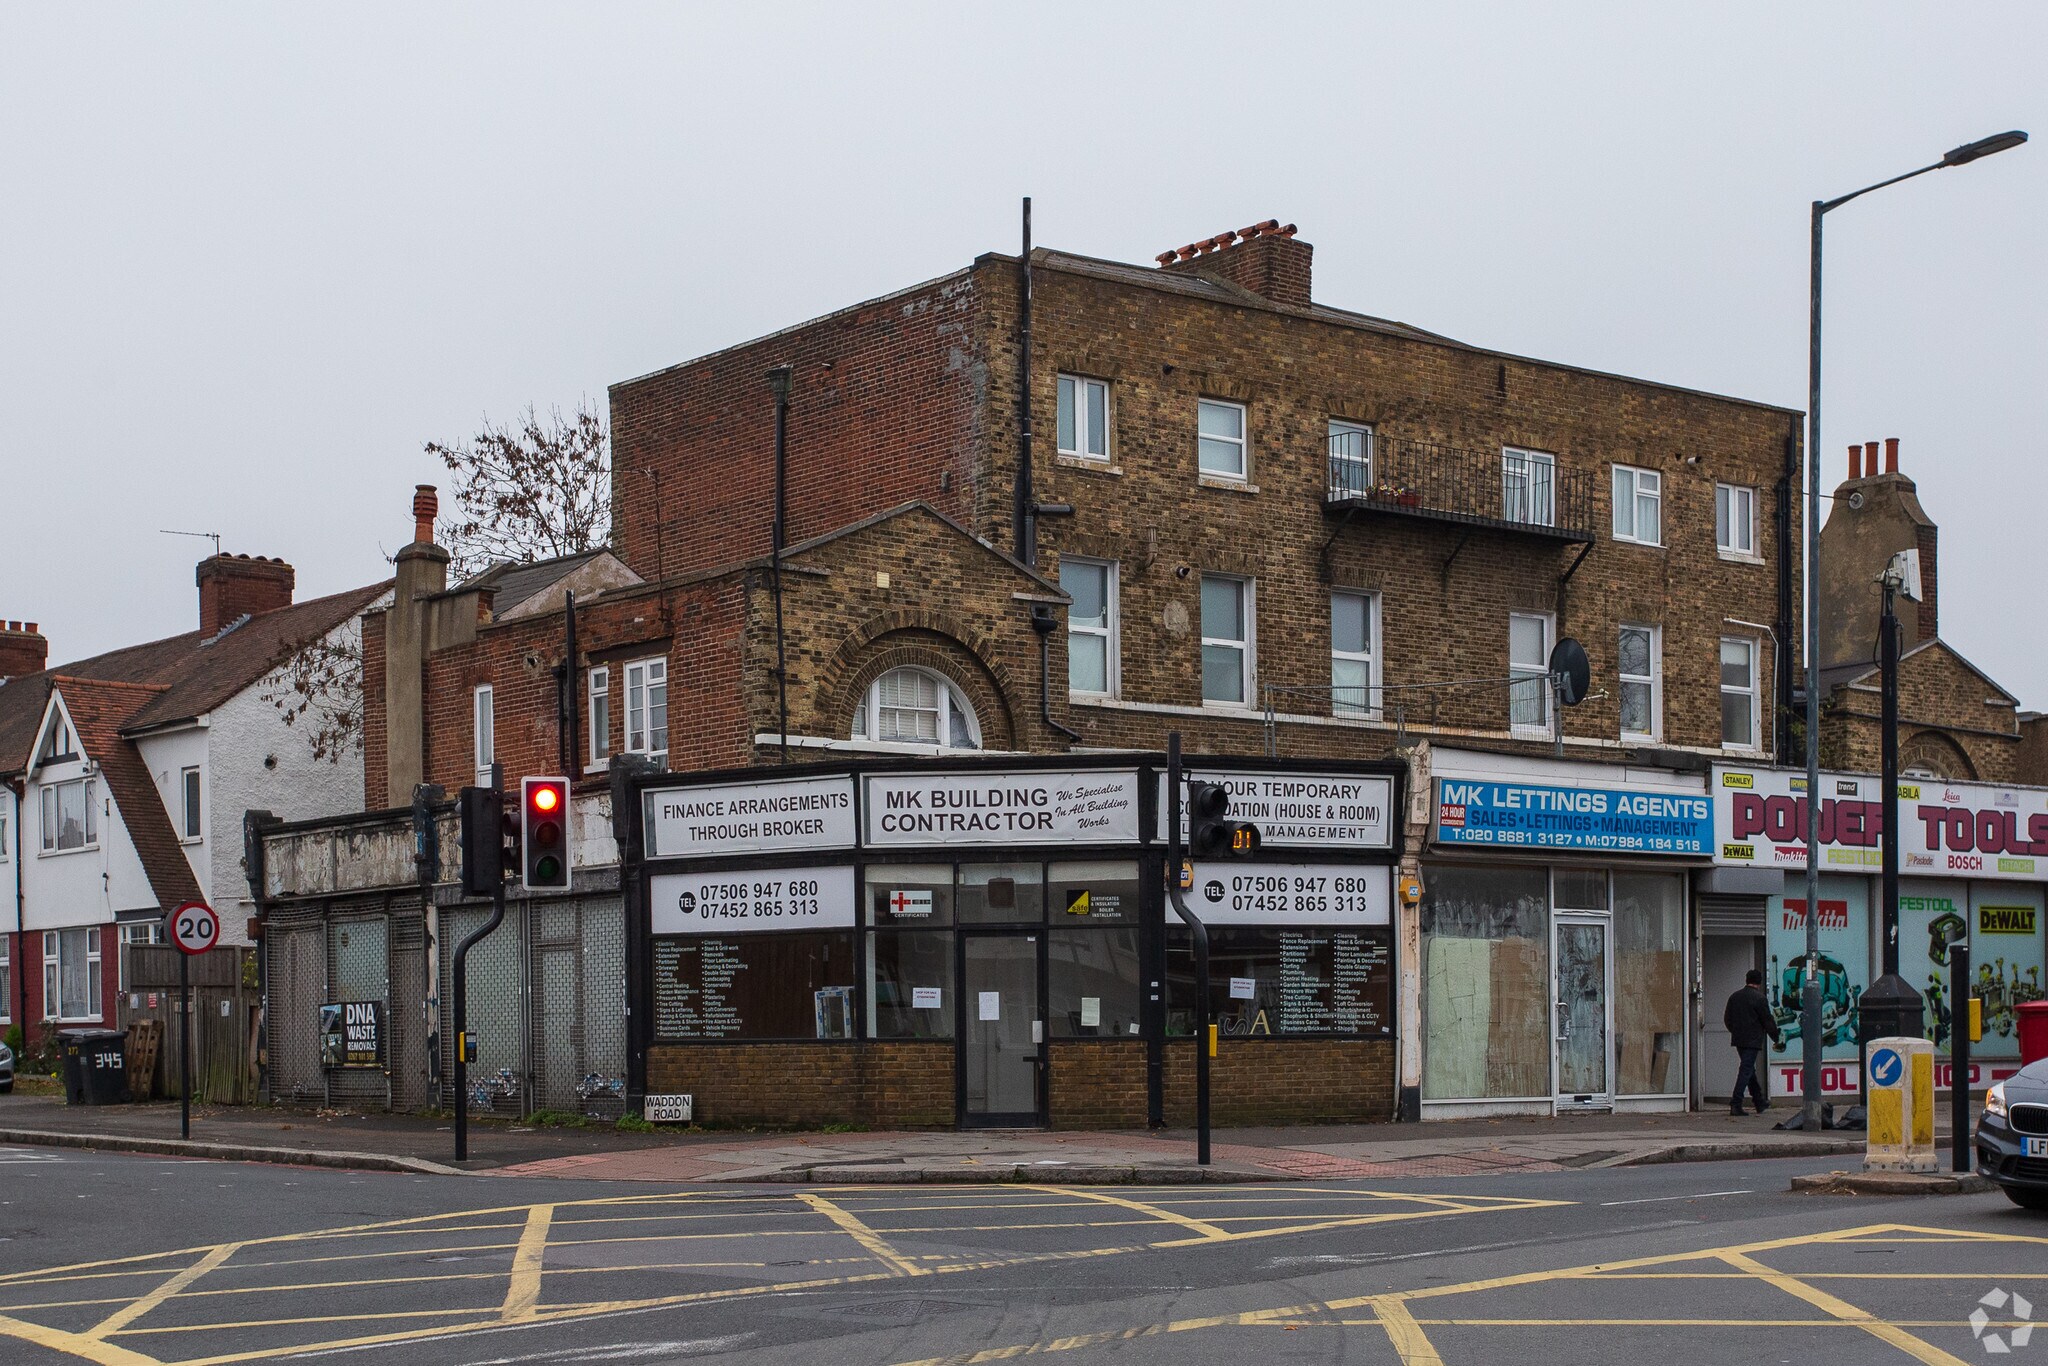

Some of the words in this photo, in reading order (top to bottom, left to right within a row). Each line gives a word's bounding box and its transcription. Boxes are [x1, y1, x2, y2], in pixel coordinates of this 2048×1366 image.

[1725, 776, 1751, 785] STANLEY
[1838, 782, 1856, 791] trend
[887, 791, 922, 808] MK
[931, 788, 1048, 808] BUILDING
[1056, 791, 1073, 801] We
[1075, 784, 1123, 800] Specialise
[1263, 783, 1361, 800] TEMPORARY
[1898, 787, 1919, 799] ABILA
[1943, 788, 1960, 803] Leica
[664, 802, 724, 819] FINANCE
[728, 793, 848, 815] ARRANGEMENTS
[1055, 806, 1066, 817] In
[1068, 804, 1085, 815] All
[1087, 799, 1128, 812] Building
[1444, 784, 1484, 806] MK
[1493, 787, 1608, 813] LETTINGS
[1616, 796, 1708, 819] AGENTS
[1275, 803, 1321, 820] (HOUSE
[1326, 805, 1334, 819] &
[1339, 806, 1380, 823] ROOM)
[1442, 806, 1448, 817] 24
[1450, 807, 1465, 818] HOUR
[881, 812, 1053, 832] CONTRACTOR
[1078, 815, 1109, 828] Works
[1471, 810, 1516, 827] SALES
[1527, 813, 1591, 831] LETTINGS
[1601, 817, 1698, 836] MANAGEMENT
[689, 823, 758, 841] THROUGH
[764, 819, 824, 837] BROKER
[1265, 826, 1365, 839] MANAGEMENT
[1918, 805, 2048, 856] TOOLS
[1453, 828, 1492, 841] T:020
[1498, 830, 1532, 843] 8681
[1538, 833, 1572, 845] 3127
[1585, 835, 1643, 848] M:07984
[1648, 838, 1672, 849] 184
[1676, 840, 1700, 851] 518
[1948, 855, 1982, 870] BOSCH
[2000, 859, 2034, 872] HITACHI
[701, 884, 748, 900] 07506
[754, 882, 782, 898] 947
[789, 880, 818, 896] 680
[1206, 886, 1224, 896] TEL:
[1232, 876, 1288, 892] 07506
[1295, 877, 1326, 892] 947
[1335, 878, 1366, 893] 680
[680, 898, 696, 908] TEL:
[701, 902, 748, 918] 07452
[754, 901, 782, 916] 865
[790, 900, 818, 915] 313
[1232, 896, 1288, 911] 07452
[1295, 896, 1327, 911] 865
[1335, 896, 1366, 911] 313
[1900, 897, 1957, 912] FESTOOL
[180, 918, 212, 939] 20
[346, 1004, 375, 1024] DNA
[1249, 1010, 1271, 1034] A
[347, 1026, 375, 1040] WASTE
[347, 1041, 376, 1051] REMOVALS
[95, 1053, 122, 1068] 345
[646, 1096, 689, 1107] WADDON
[654, 1109, 681, 1119] ROAD
[2031, 1140, 2048, 1154] LF
